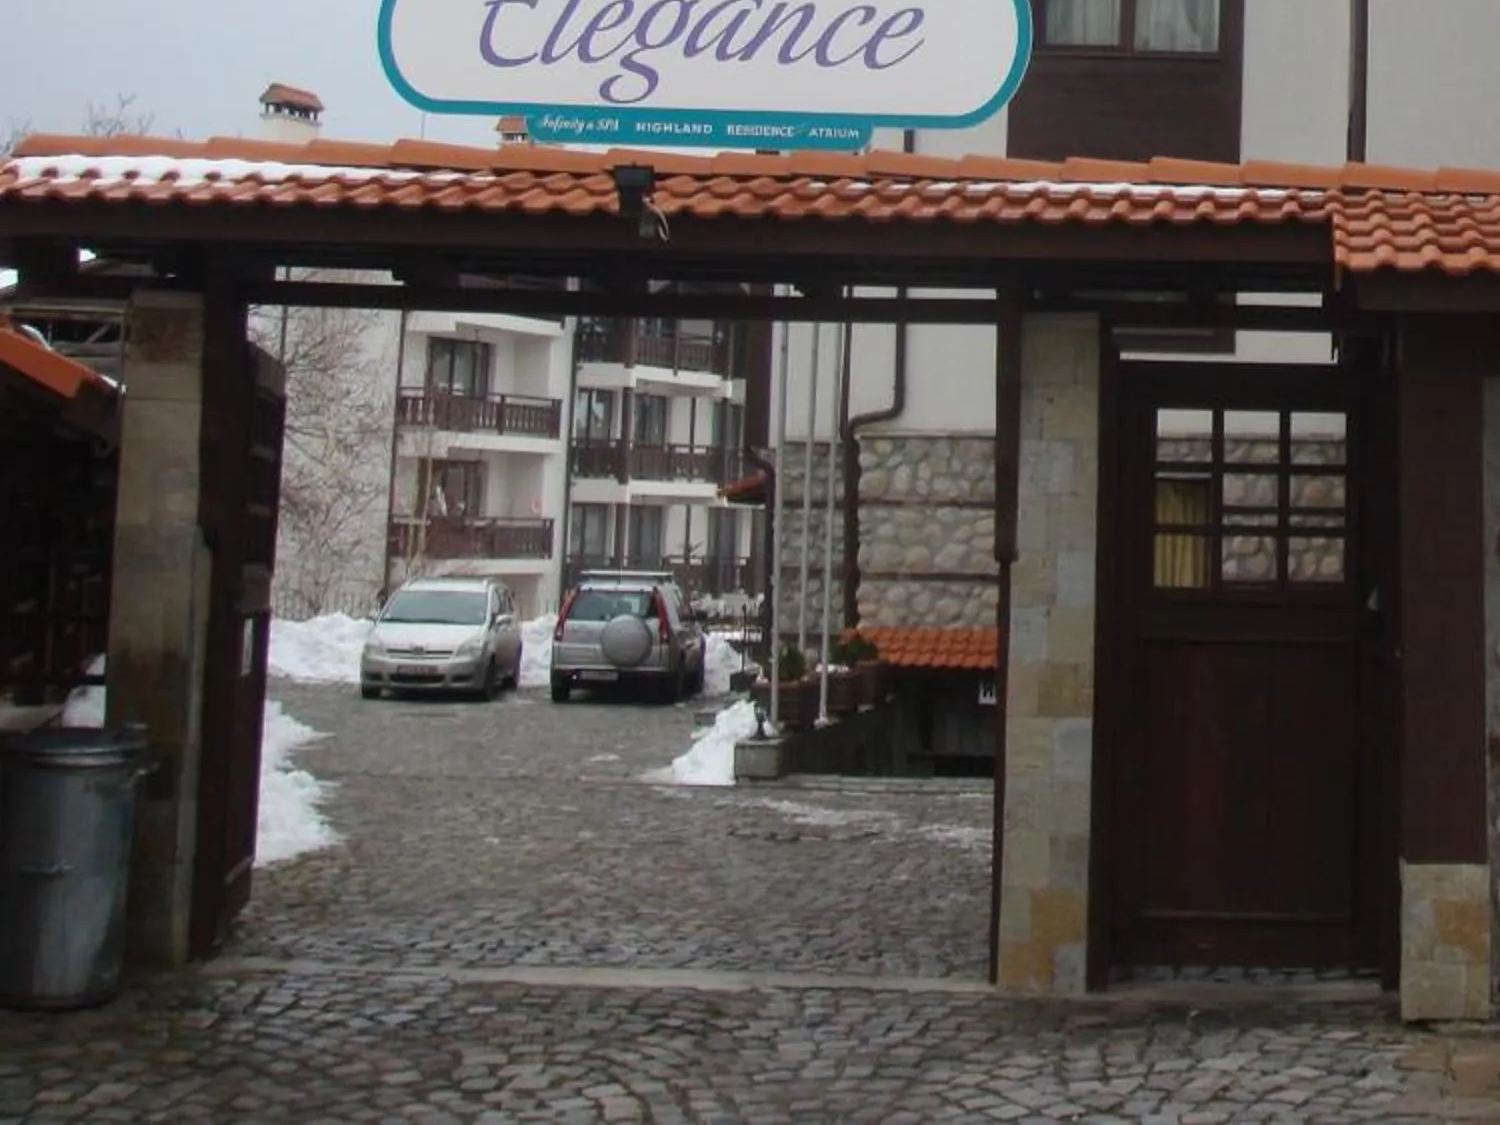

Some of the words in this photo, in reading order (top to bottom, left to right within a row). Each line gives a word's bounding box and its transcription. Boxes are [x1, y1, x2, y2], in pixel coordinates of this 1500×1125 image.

[635, 122, 713, 134] HIGHLAND
[727, 124, 796, 138] RESIDENCE
[808, 127, 861, 140] ATRIUM
